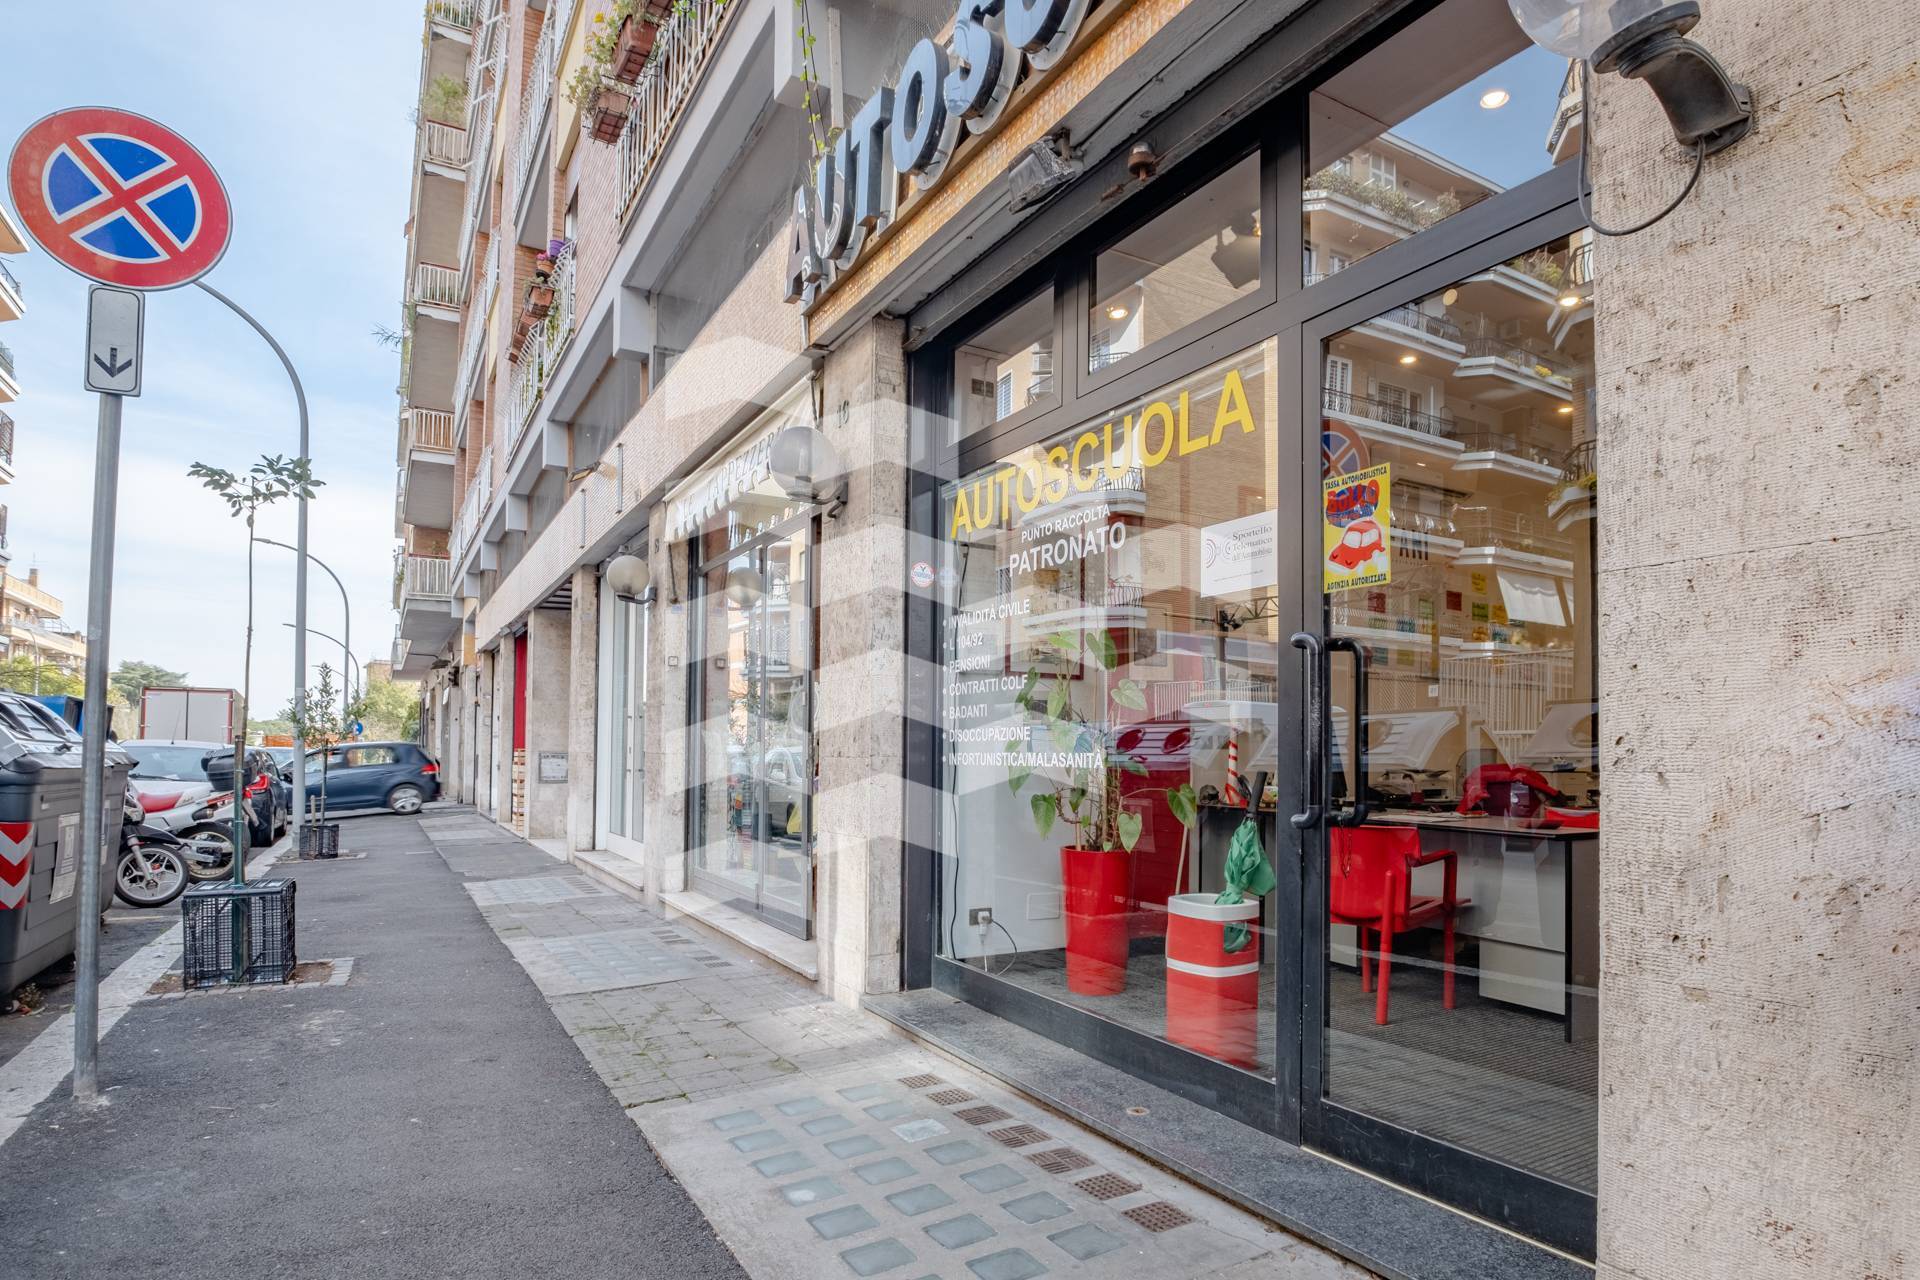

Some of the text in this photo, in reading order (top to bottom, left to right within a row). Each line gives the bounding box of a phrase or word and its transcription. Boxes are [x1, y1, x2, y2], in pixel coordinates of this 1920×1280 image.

[951, 369, 1256, 539] AUTOSCUOLA
[1325, 466, 1388, 489] TASSA AUTOMOBILISTICA
[1021, 504, 1111, 542] PUNTO RACCOLTA
[1232, 524, 1273, 541] Sportello
[1008, 522, 1127, 577] PATRONATO
[1327, 572, 1387, 590] AGENZIA AUTORIZZATA
[948, 598, 1031, 630] INVALIDITÀ CIVILE
[957, 632, 984, 650] 104/92
[948, 655, 991, 673] PENSIONI
[949, 674, 1029, 697] CONTRATTI COLF
[948, 703, 988, 720] BADANTI
[948, 726, 1031, 743] DISOCCUPAZIONE
